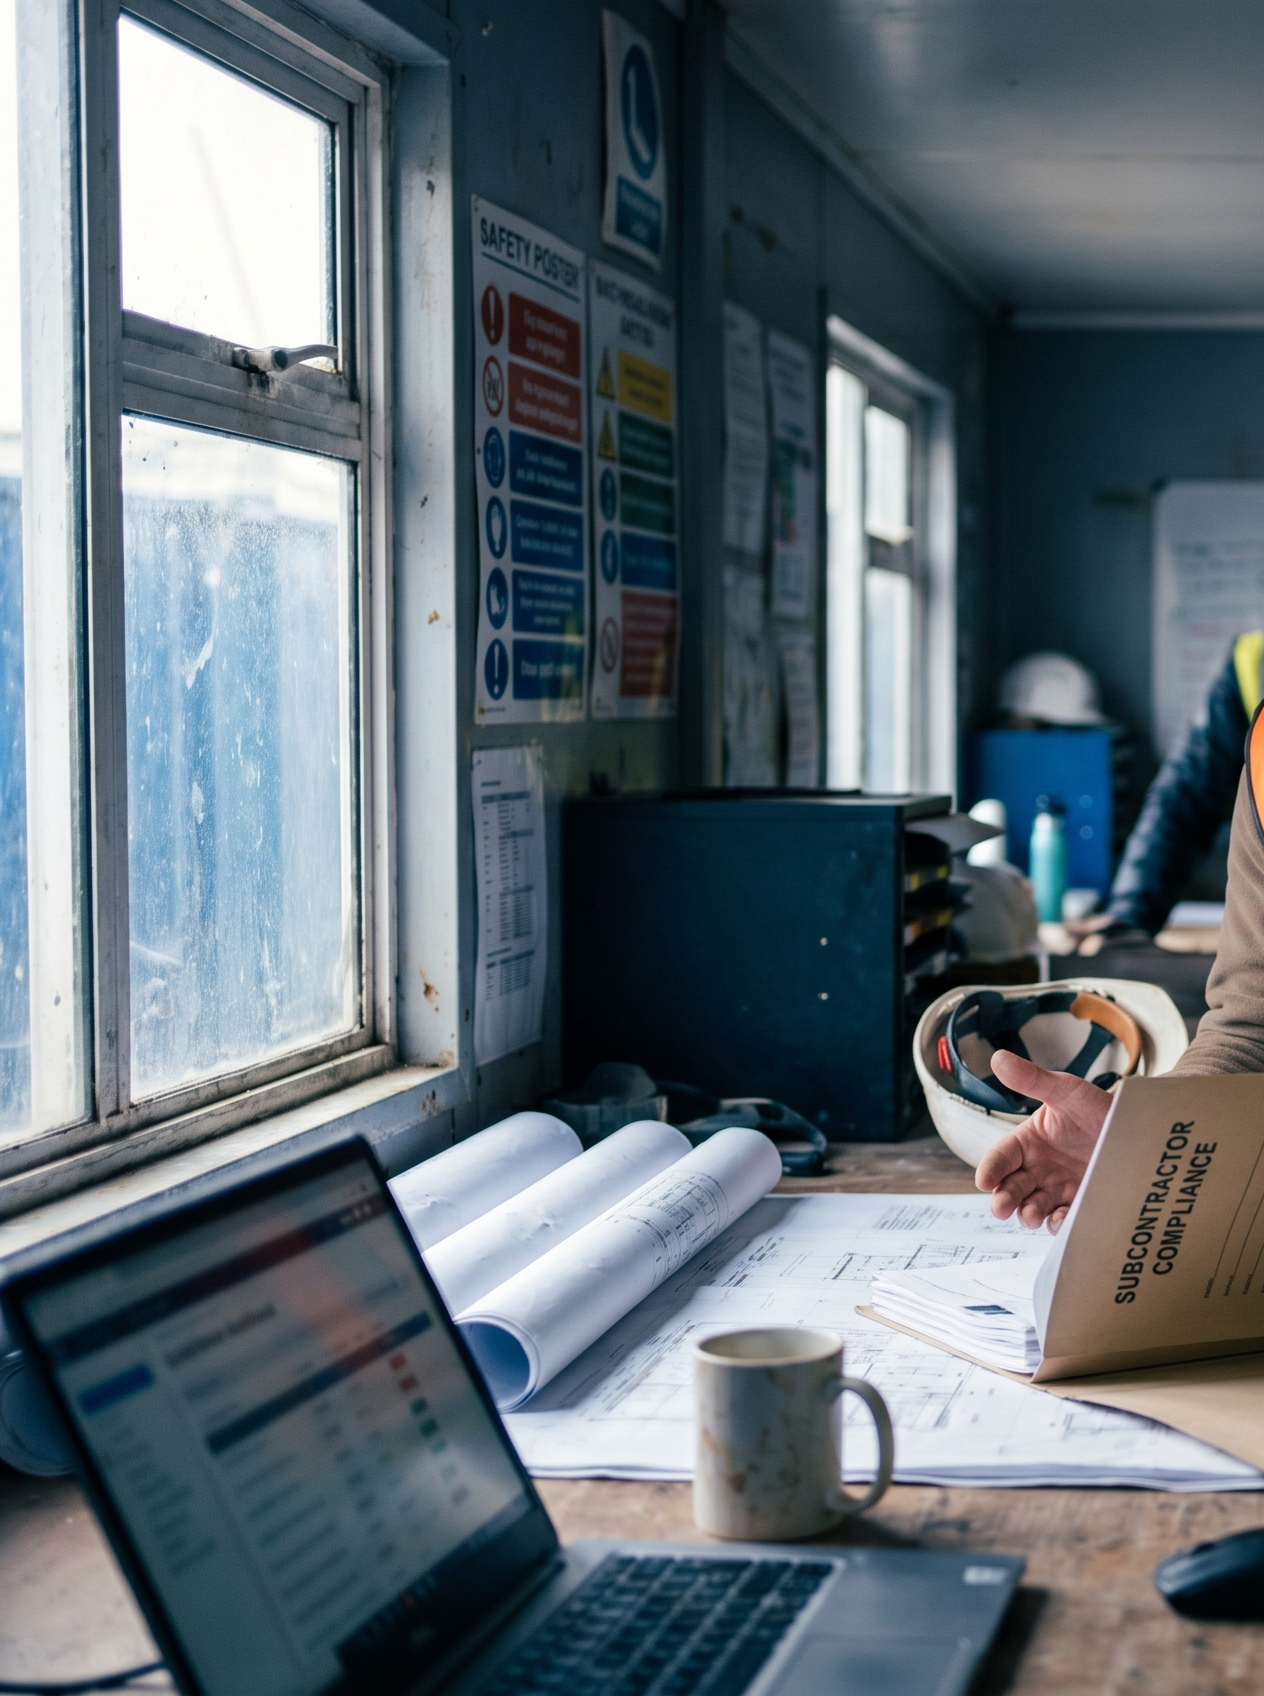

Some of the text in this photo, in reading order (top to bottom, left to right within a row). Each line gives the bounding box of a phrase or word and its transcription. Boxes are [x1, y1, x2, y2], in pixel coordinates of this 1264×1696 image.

[481, 217, 579, 289] SAFETY POSTER
[1114, 1120, 1195, 1304] SUBCONTRACTOR
[1152, 1142, 1218, 1275] COMPLIANCE
